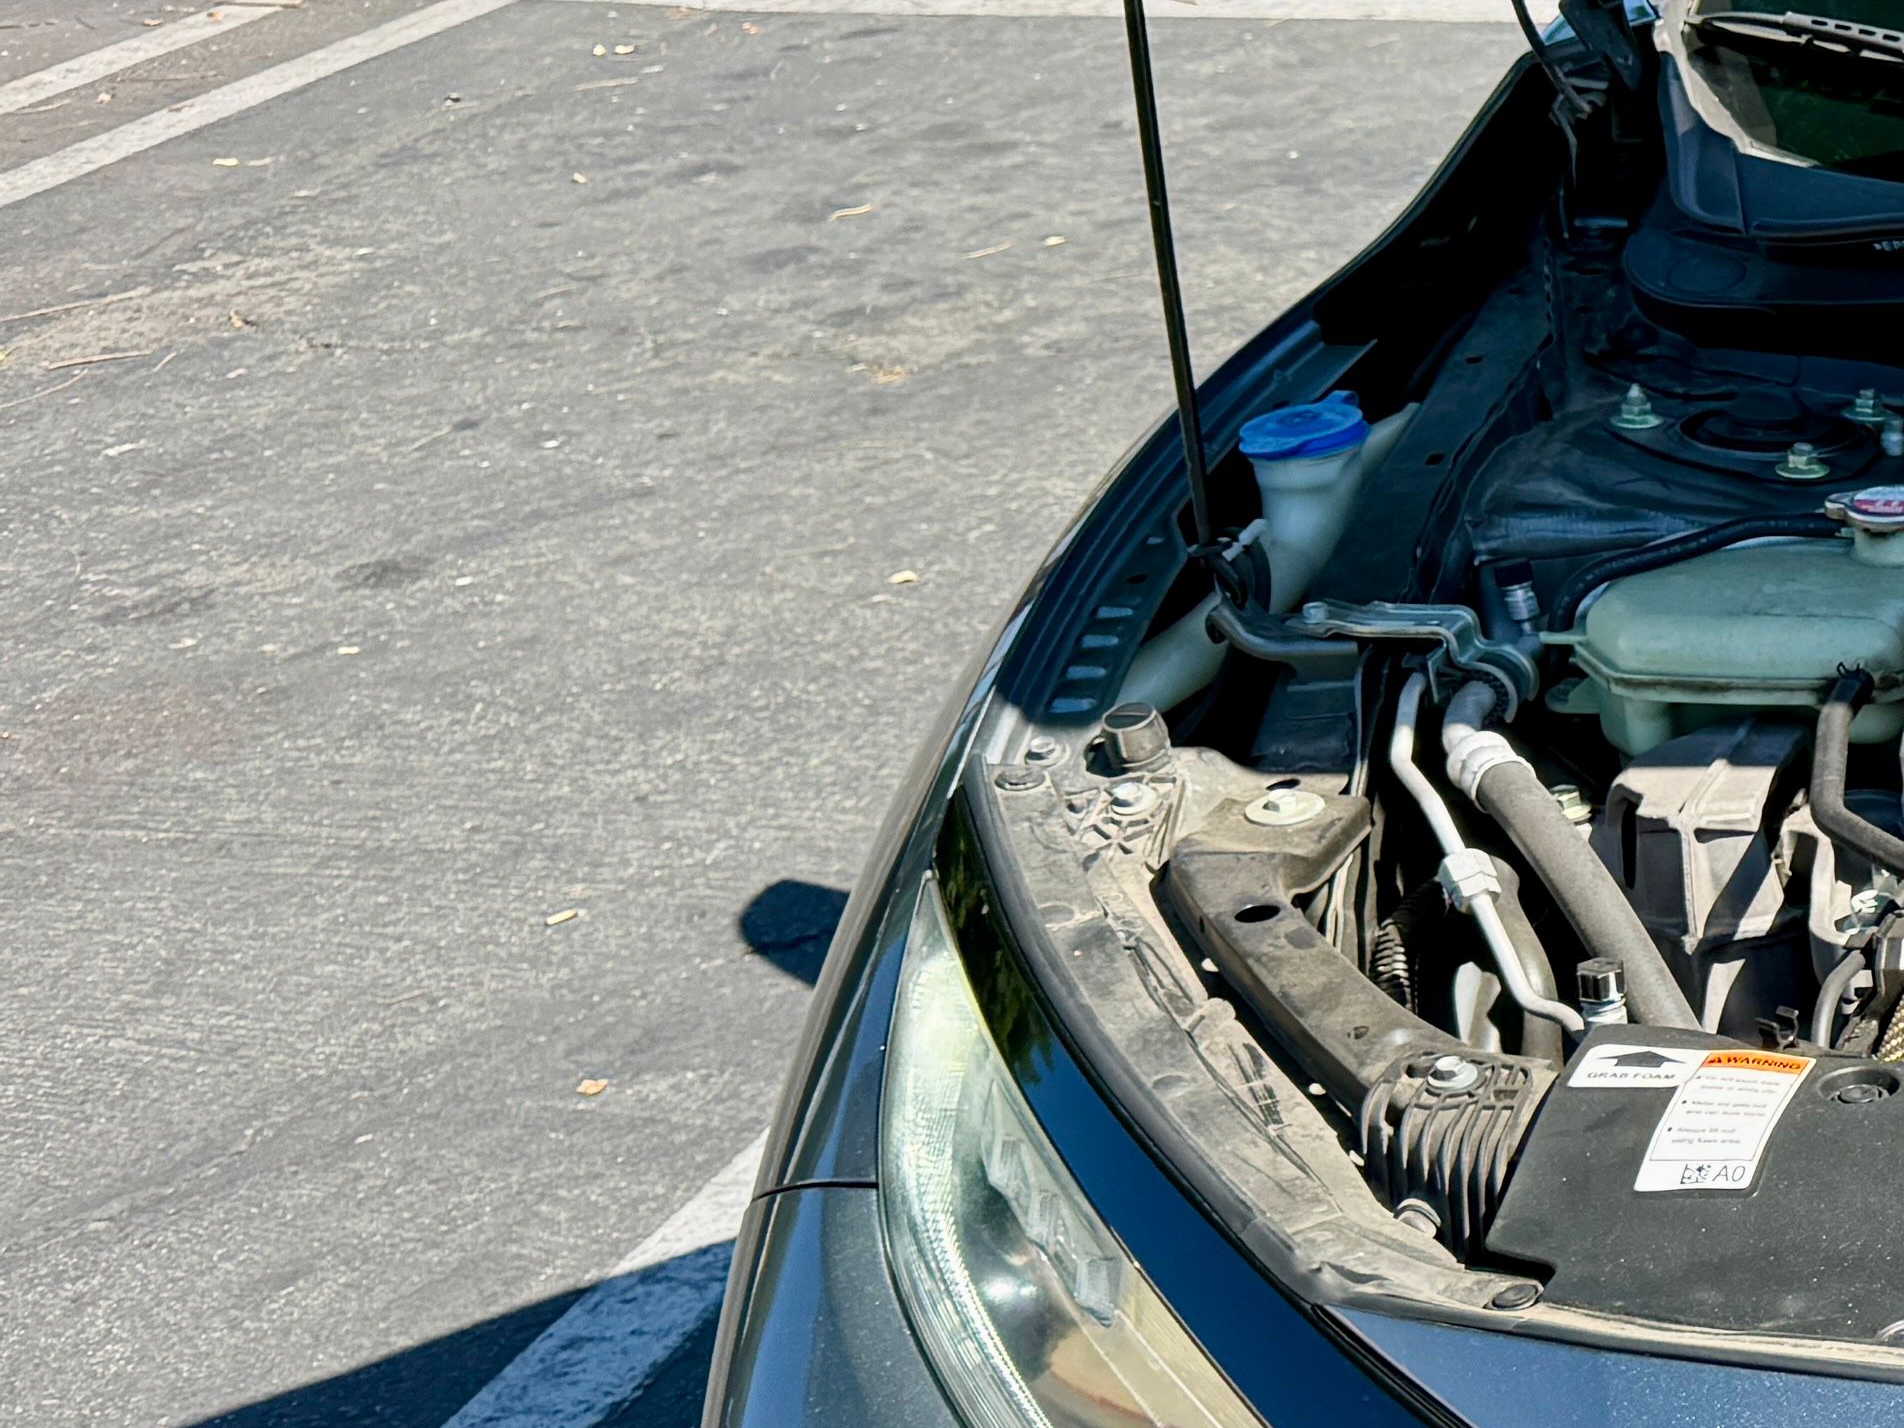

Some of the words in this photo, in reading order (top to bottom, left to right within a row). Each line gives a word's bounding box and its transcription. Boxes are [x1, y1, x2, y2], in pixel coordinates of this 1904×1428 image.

[1726, 1056, 1803, 1071] WARNING
[1587, 1071, 1629, 1080] GRAB
[1631, 1072, 1677, 1081] FOAM
